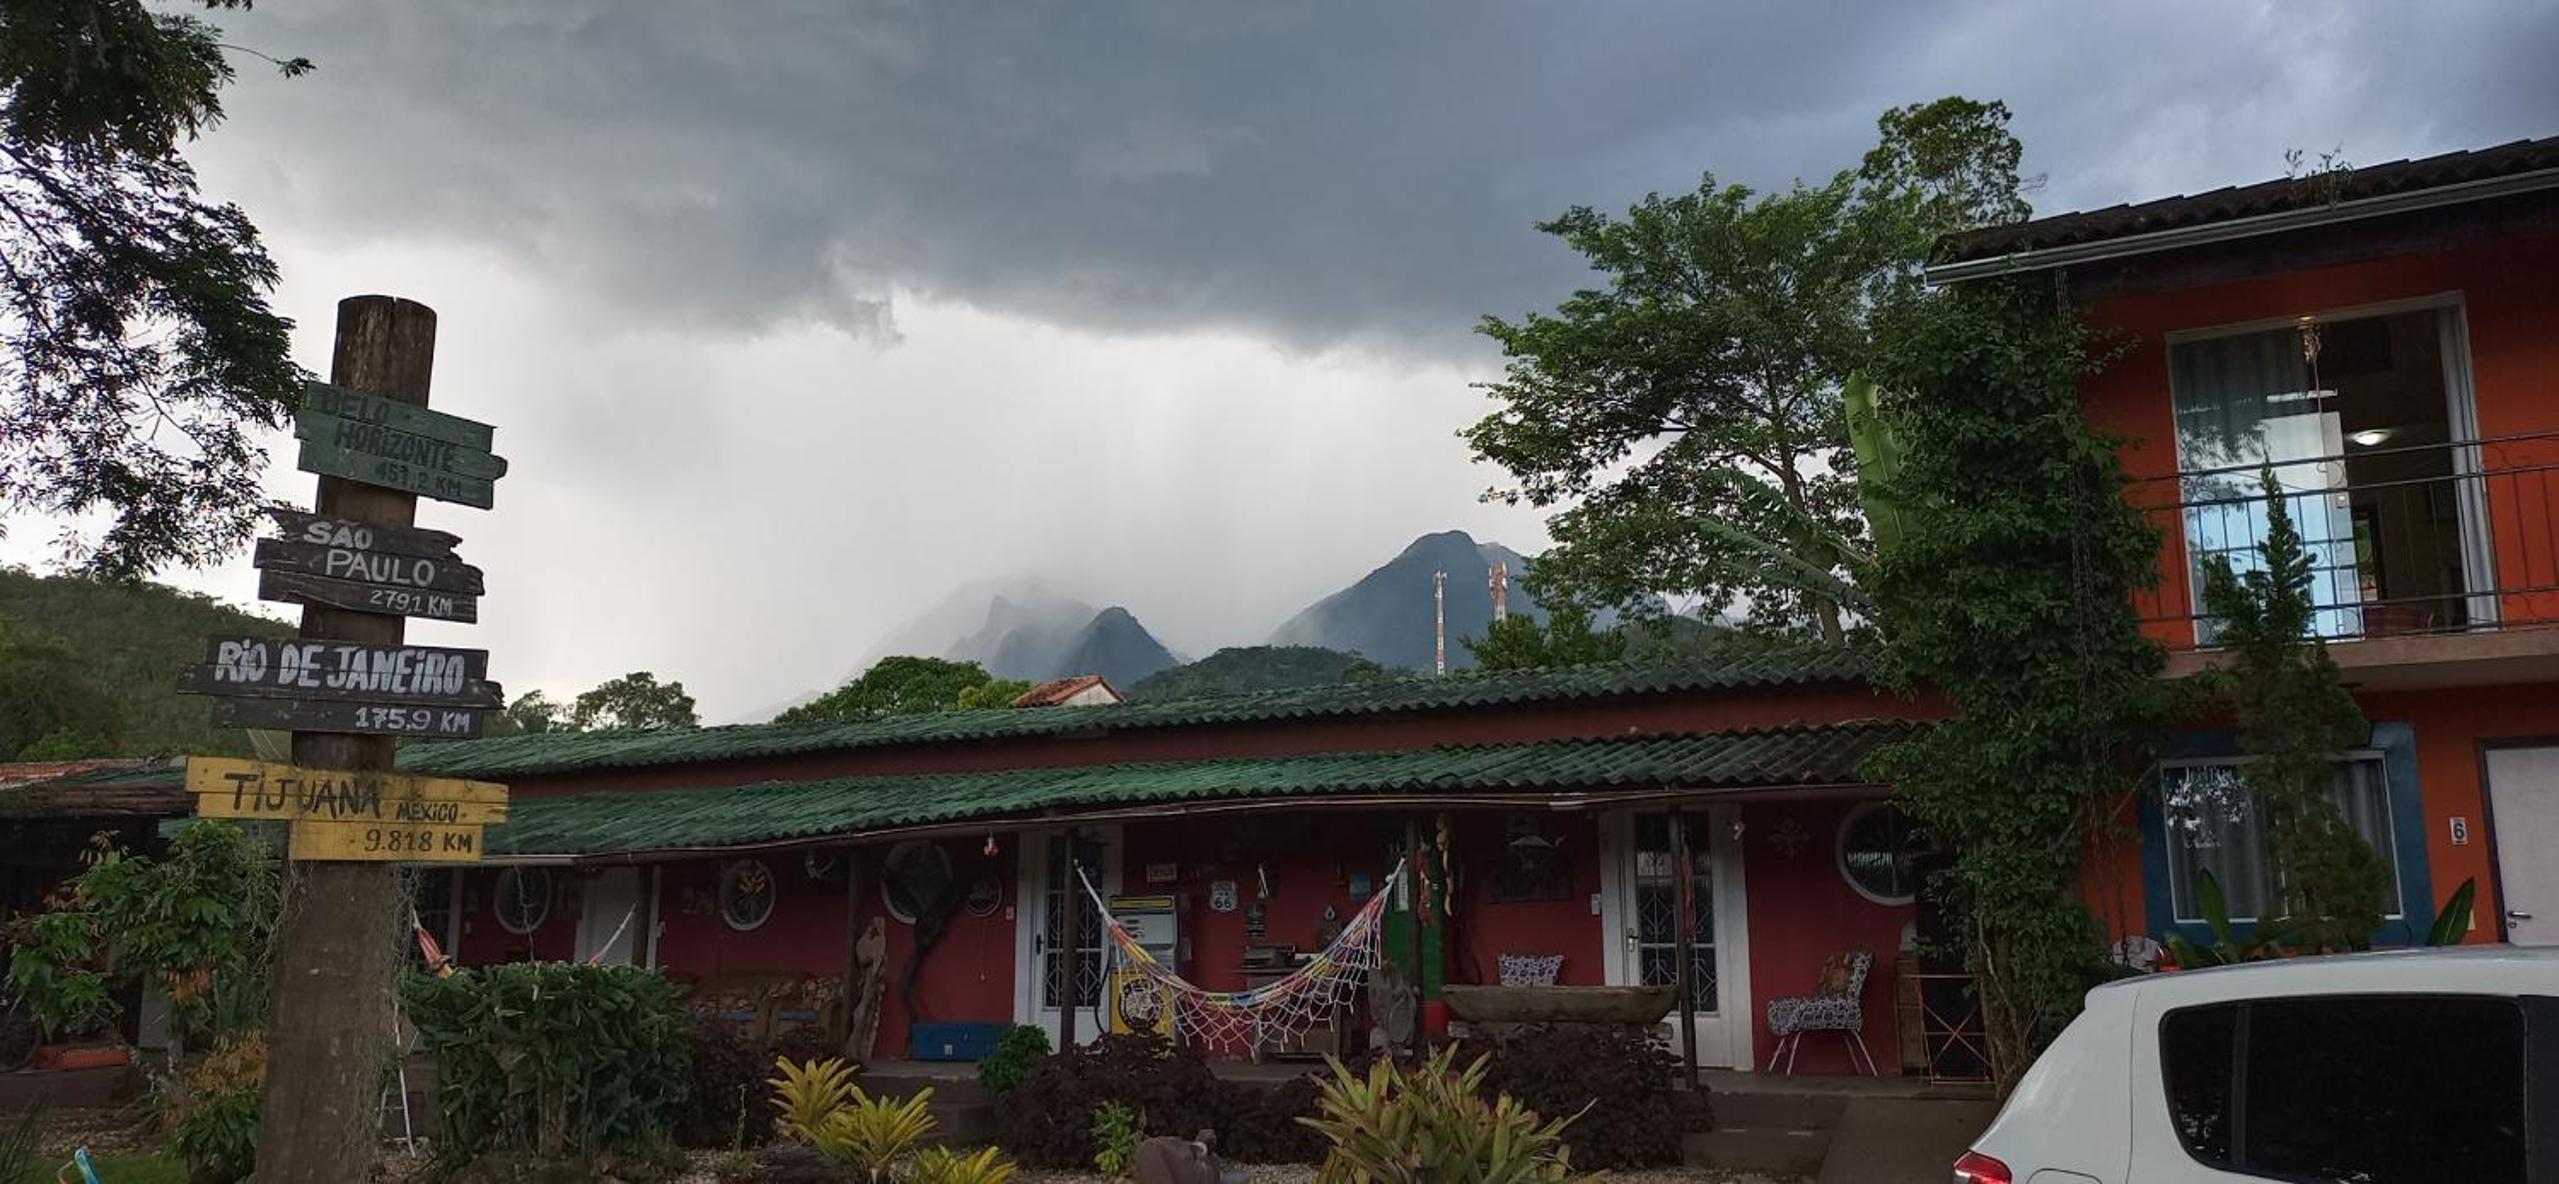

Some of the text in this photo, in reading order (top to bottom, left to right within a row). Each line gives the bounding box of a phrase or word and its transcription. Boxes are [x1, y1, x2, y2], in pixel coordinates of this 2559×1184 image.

[320, 391, 390, 423] BELO
[436, 474, 462, 497] KM
[303, 519, 373, 550] SÃO
[325, 549, 435, 587] PAULO
[427, 594, 453, 617] KM
[277, 642, 325, 687] DE
[439, 711, 471, 734] KM
[2453, 822, 2465, 840] 6
[442, 832, 473, 854] KM
[1215, 896, 1232, 909] 66
